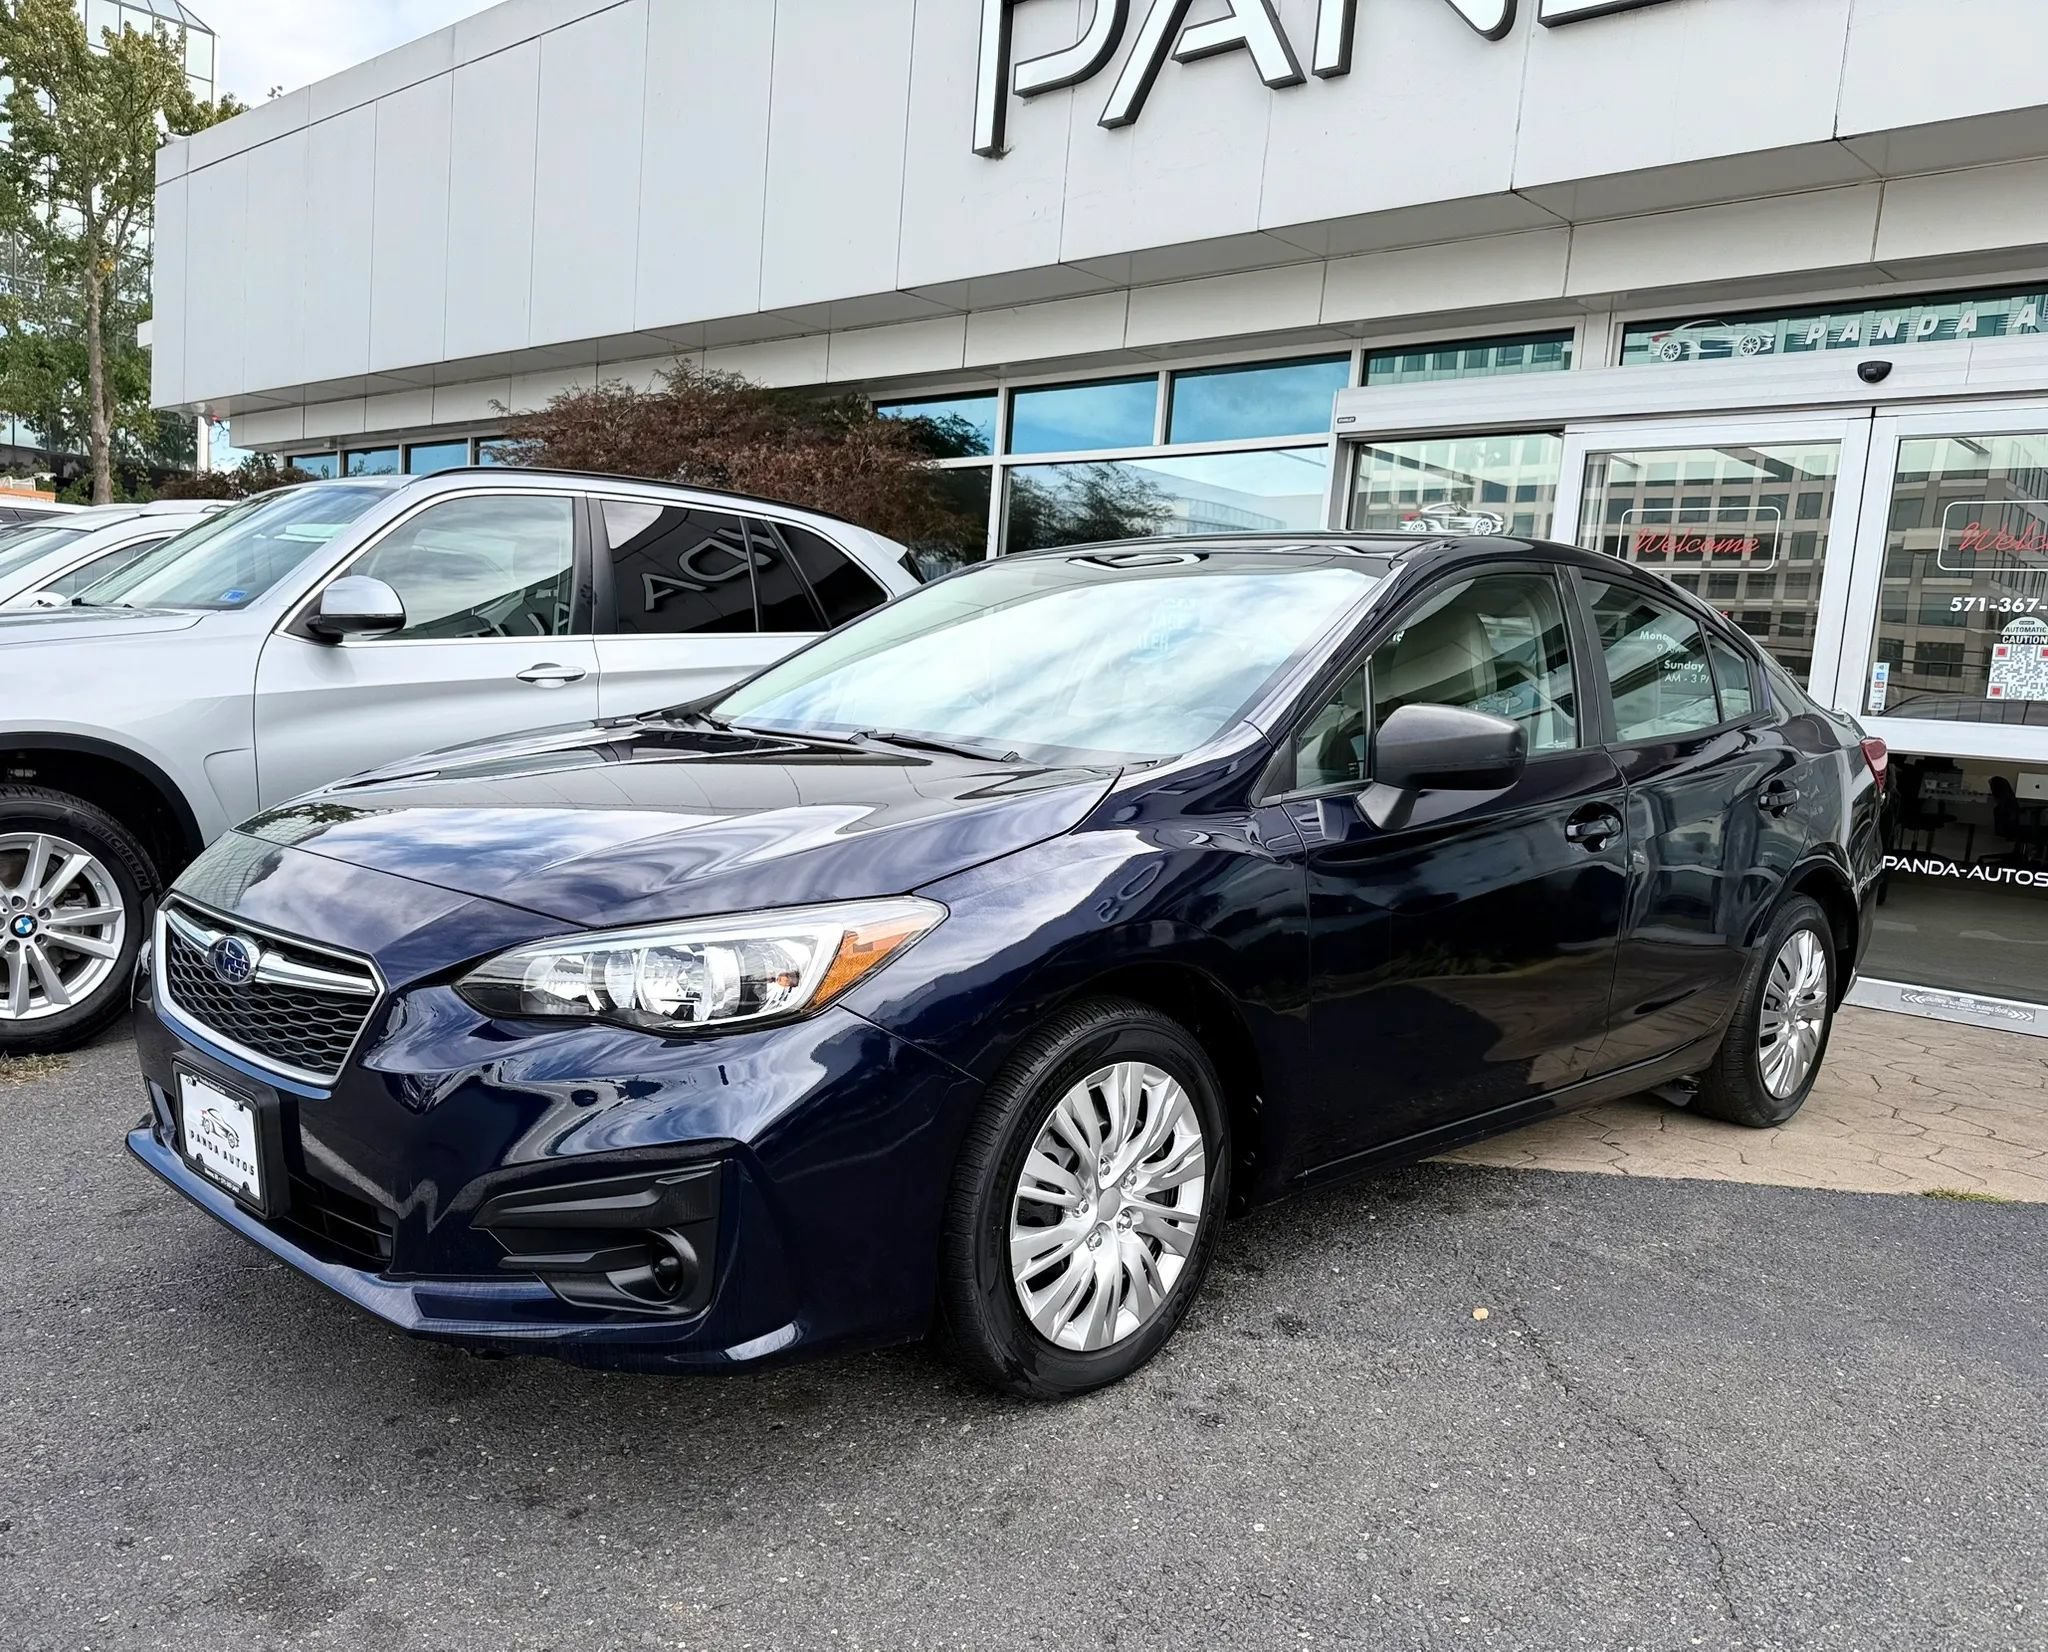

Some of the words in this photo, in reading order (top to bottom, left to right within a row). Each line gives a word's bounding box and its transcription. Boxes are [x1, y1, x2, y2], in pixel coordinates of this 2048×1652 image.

[1803, 309, 1978, 345] PANDA
[1633, 527, 1761, 554] Welcome
[1958, 519, 2048, 552] Welc
[1950, 596, 2048, 613] 571-367-
[2002, 635, 2048, 644] CAUTION
[1663, 660, 1705, 673] Sunday
[1664, 673, 1681, 682] AM
[1690, 674, 1698, 683] 3
[1881, 855, 2048, 888] PANDA-AUTOS
[190, 1129, 219, 1156] PANDA
[223, 1150, 255, 1176] AUTOS
